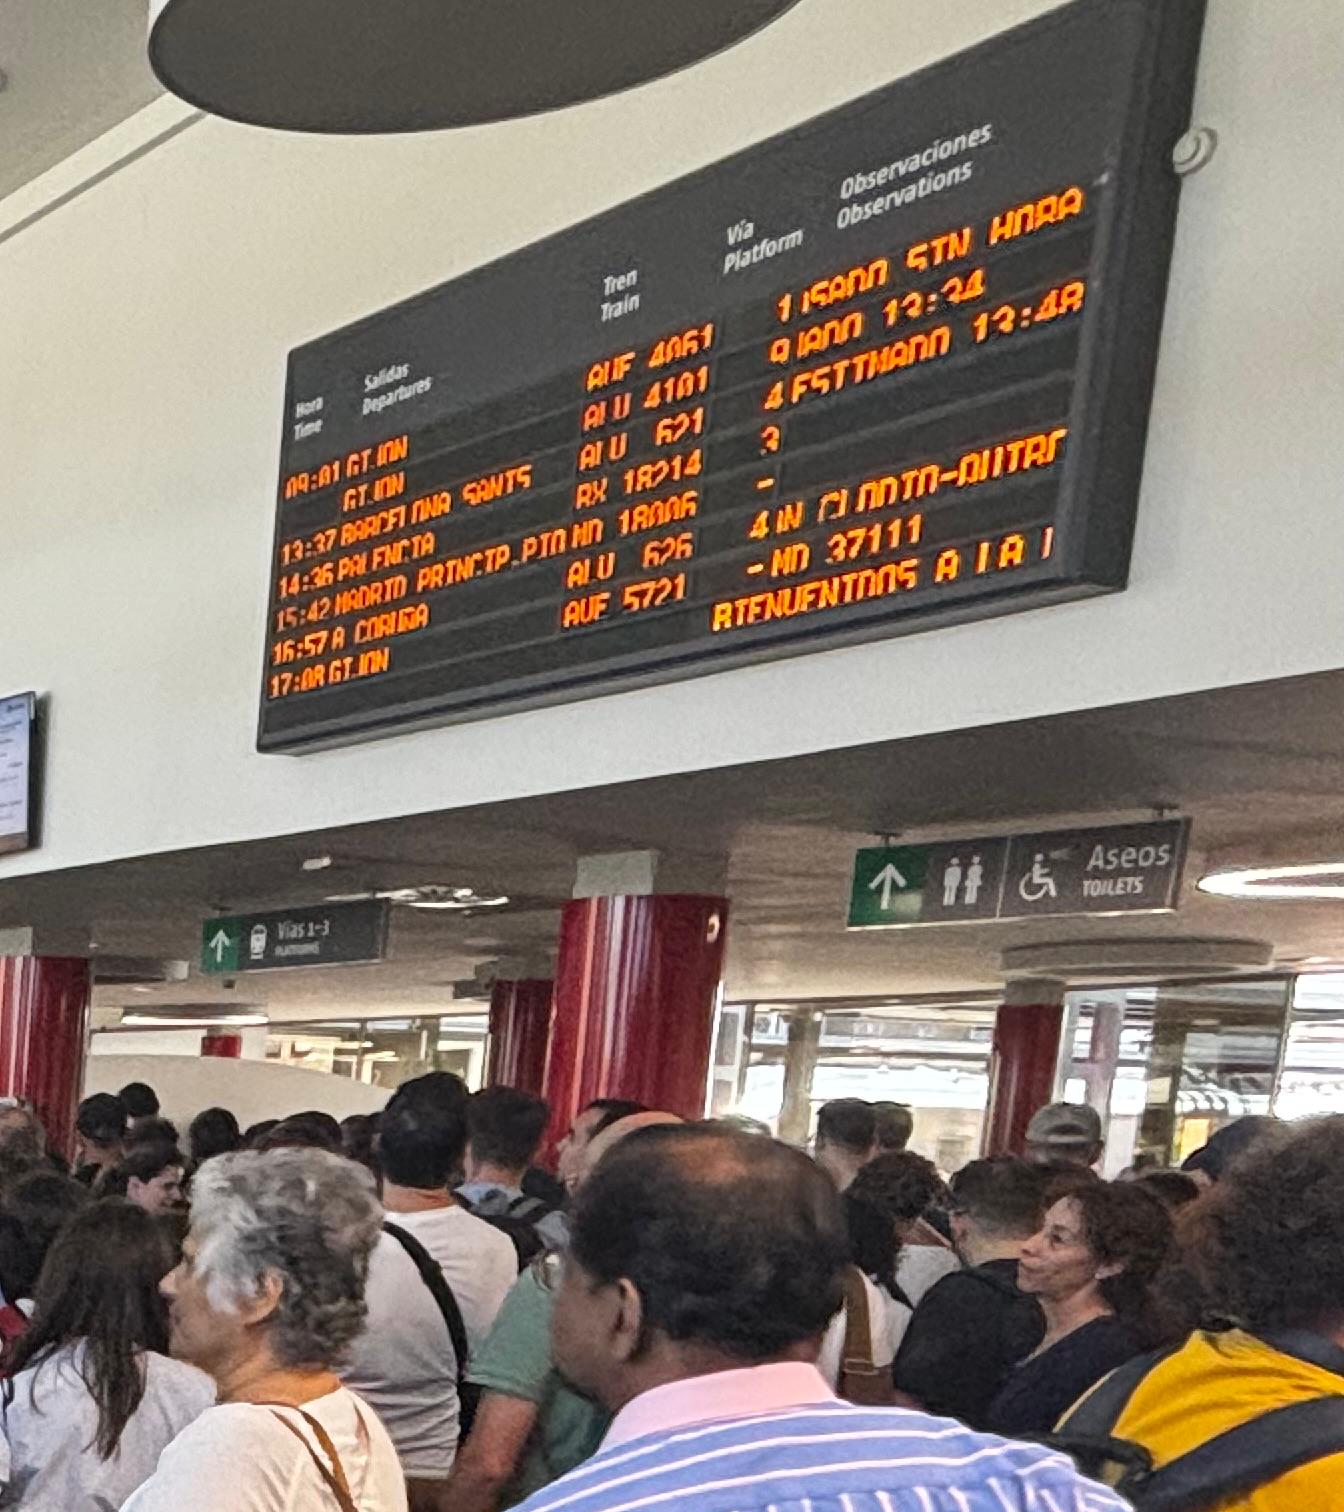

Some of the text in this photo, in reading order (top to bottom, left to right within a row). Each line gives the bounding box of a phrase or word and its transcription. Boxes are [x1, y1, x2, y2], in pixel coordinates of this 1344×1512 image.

[840, 122, 993, 201] Observaciones
[836, 160, 973, 230] Observations
[722, 228, 804, 275] Platform
[603, 269, 638, 297] Tren
[600, 292, 640, 322] Train
[364, 363, 411, 392] Salidas
[362, 376, 433, 415] Departures
[294, 418, 323, 440] Time
[1085, 844, 1171, 872] Aseos
[1082, 876, 1145, 897] TOILETS
[306, 919, 330, 938] 1-3
